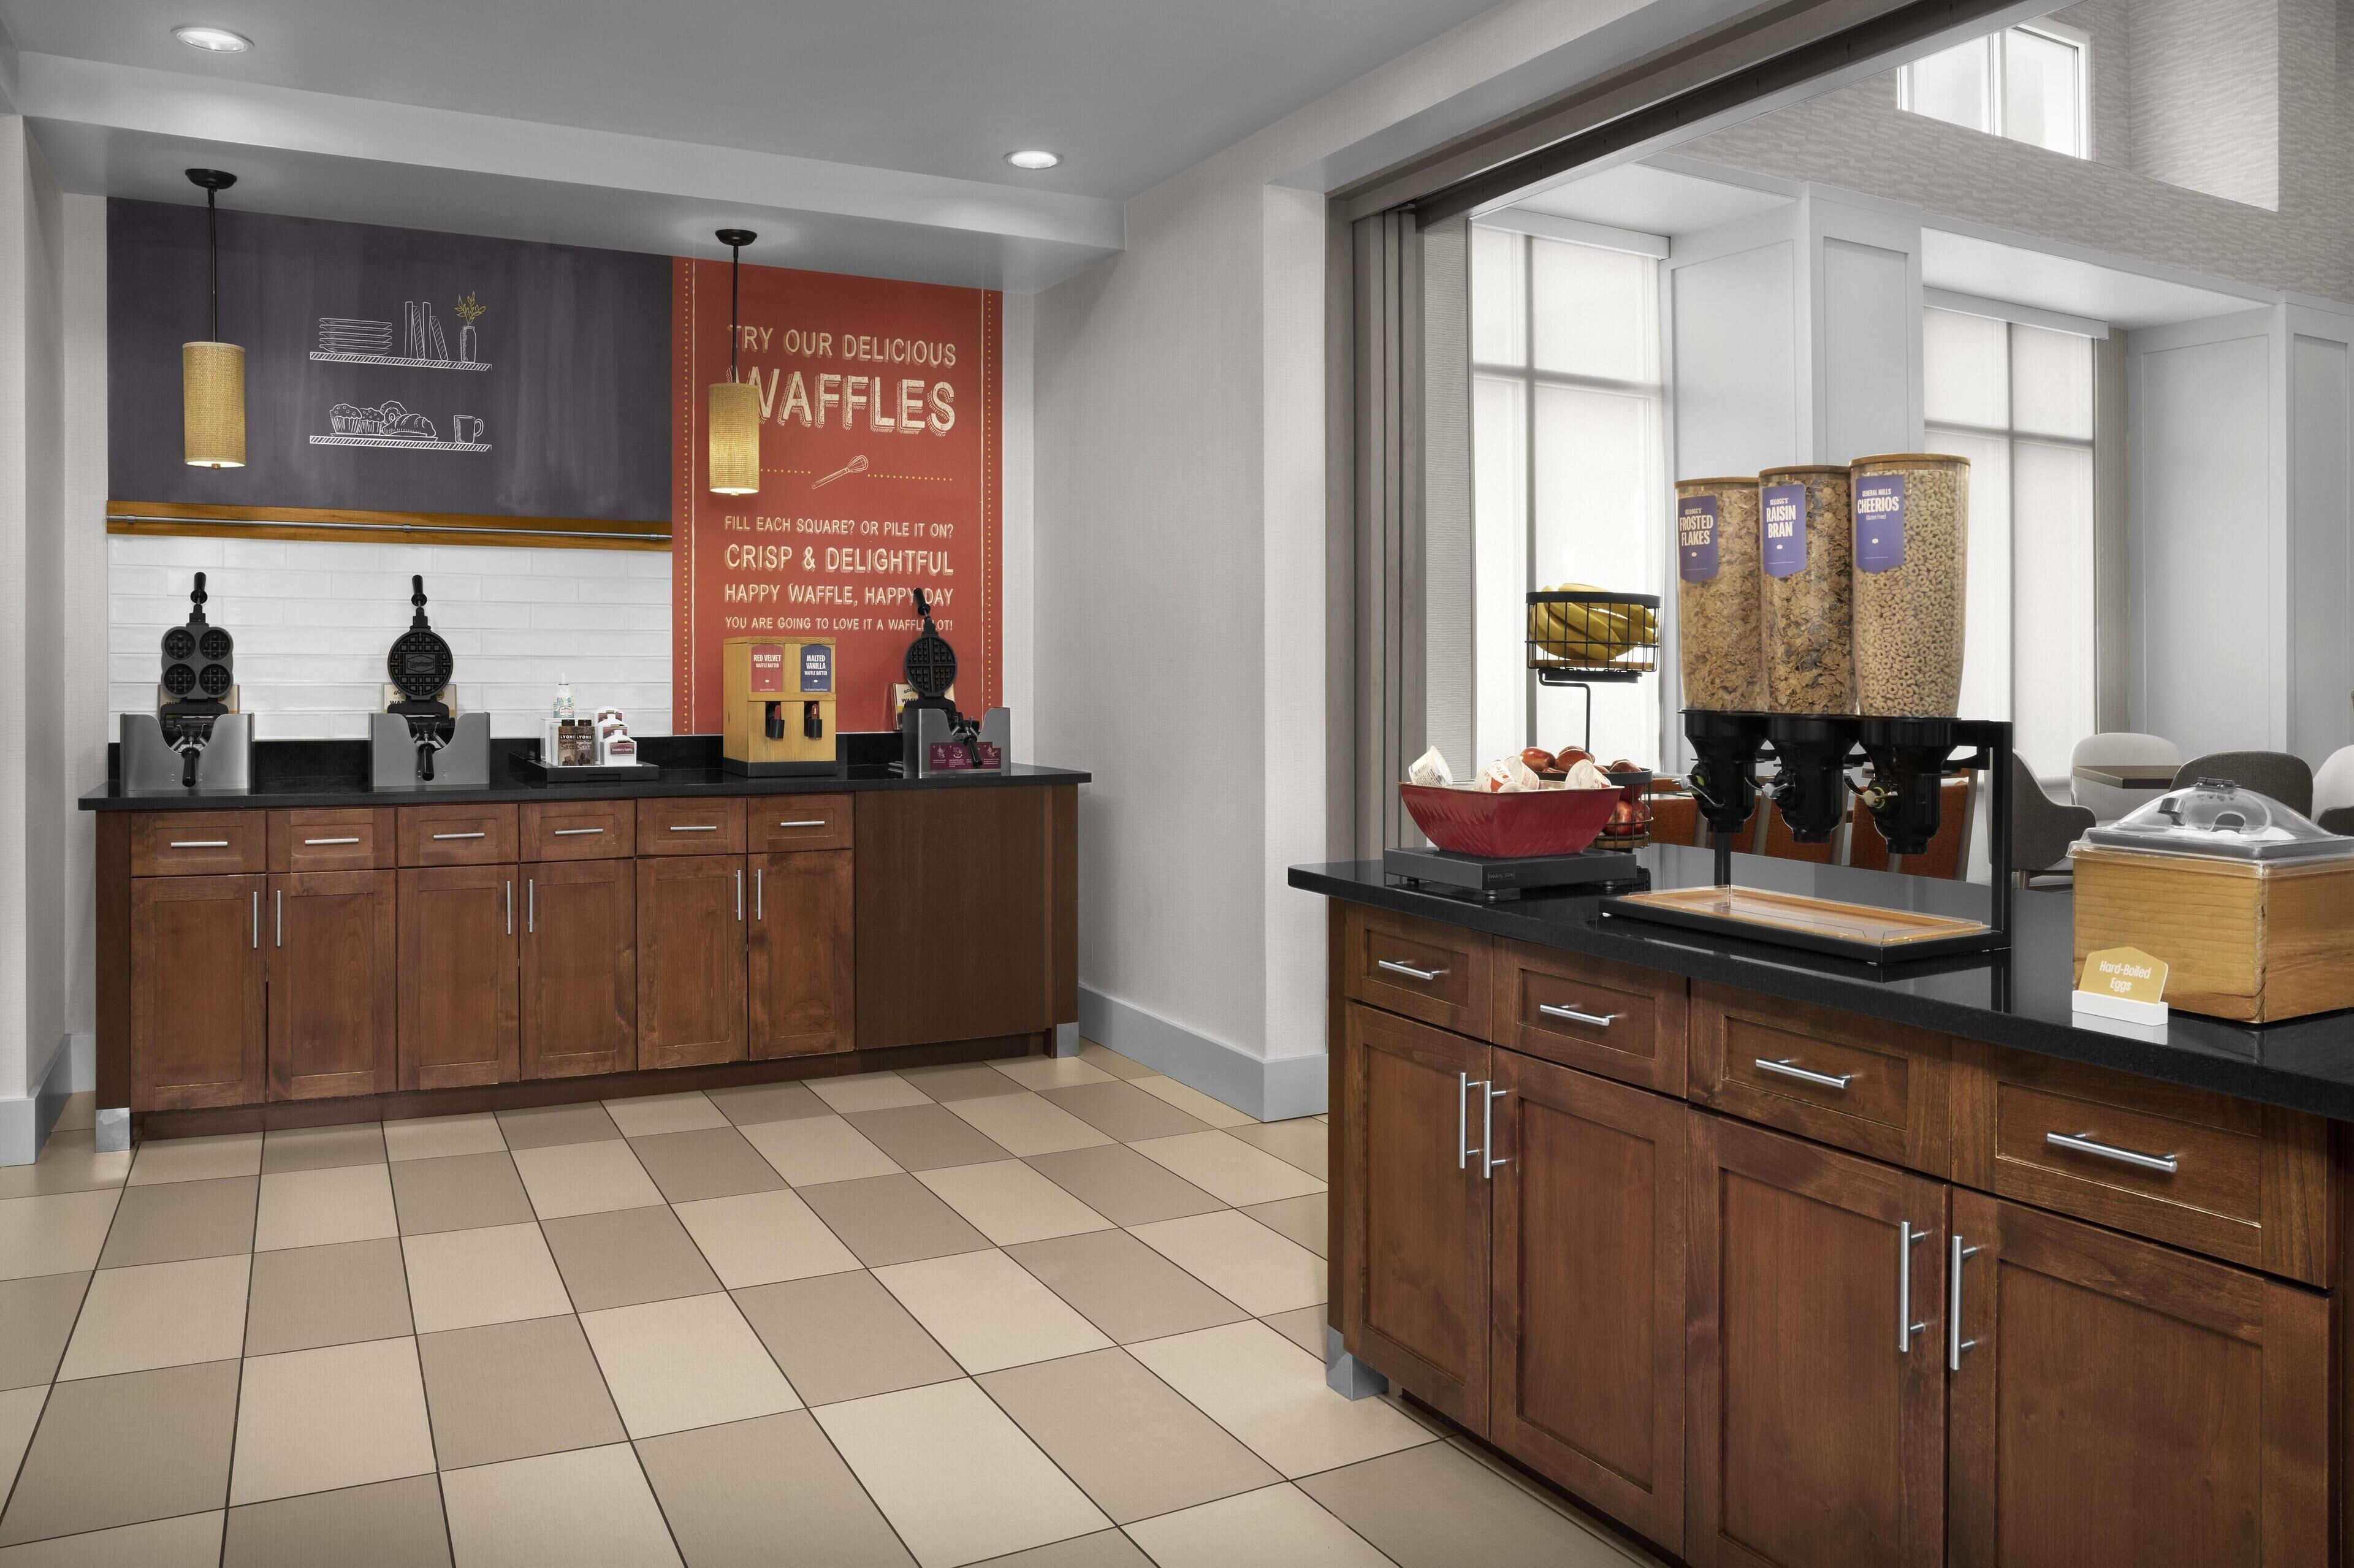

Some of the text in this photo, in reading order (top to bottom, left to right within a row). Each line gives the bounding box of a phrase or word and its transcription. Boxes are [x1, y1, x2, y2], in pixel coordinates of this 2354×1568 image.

[783, 329, 833, 358] OUR
[842, 334, 956, 369] DELICIOUS
[1766, 504, 1797, 522] RAISIN
[1857, 496, 1899, 514] CHEERIOS
[725, 516, 954, 538] FILL EACH SQUARE? OR PILE IT ON?
[1680, 515, 1714, 531] FROSTED
[1768, 521, 1794, 538] BRAN
[1682, 530, 1711, 546] FLAKES
[725, 544, 954, 576] CRISP & DELIGHTFUL
[725, 583, 953, 607] HAPPY WAFFLE, HAPPY DAY
[725, 617, 747, 630] YOU
[750, 617, 774, 630] ARE
[777, 617, 811, 631] GOING
[815, 617, 829, 630] TO
[832, 617, 859, 631] LOVE
[863, 618, 872, 631] IT
[875, 618, 883, 631] A
[932, 619, 953, 632] OT!
[2099, 961, 2152, 979] Hard-Boiled
[2110, 977, 2132, 993] Eggs
